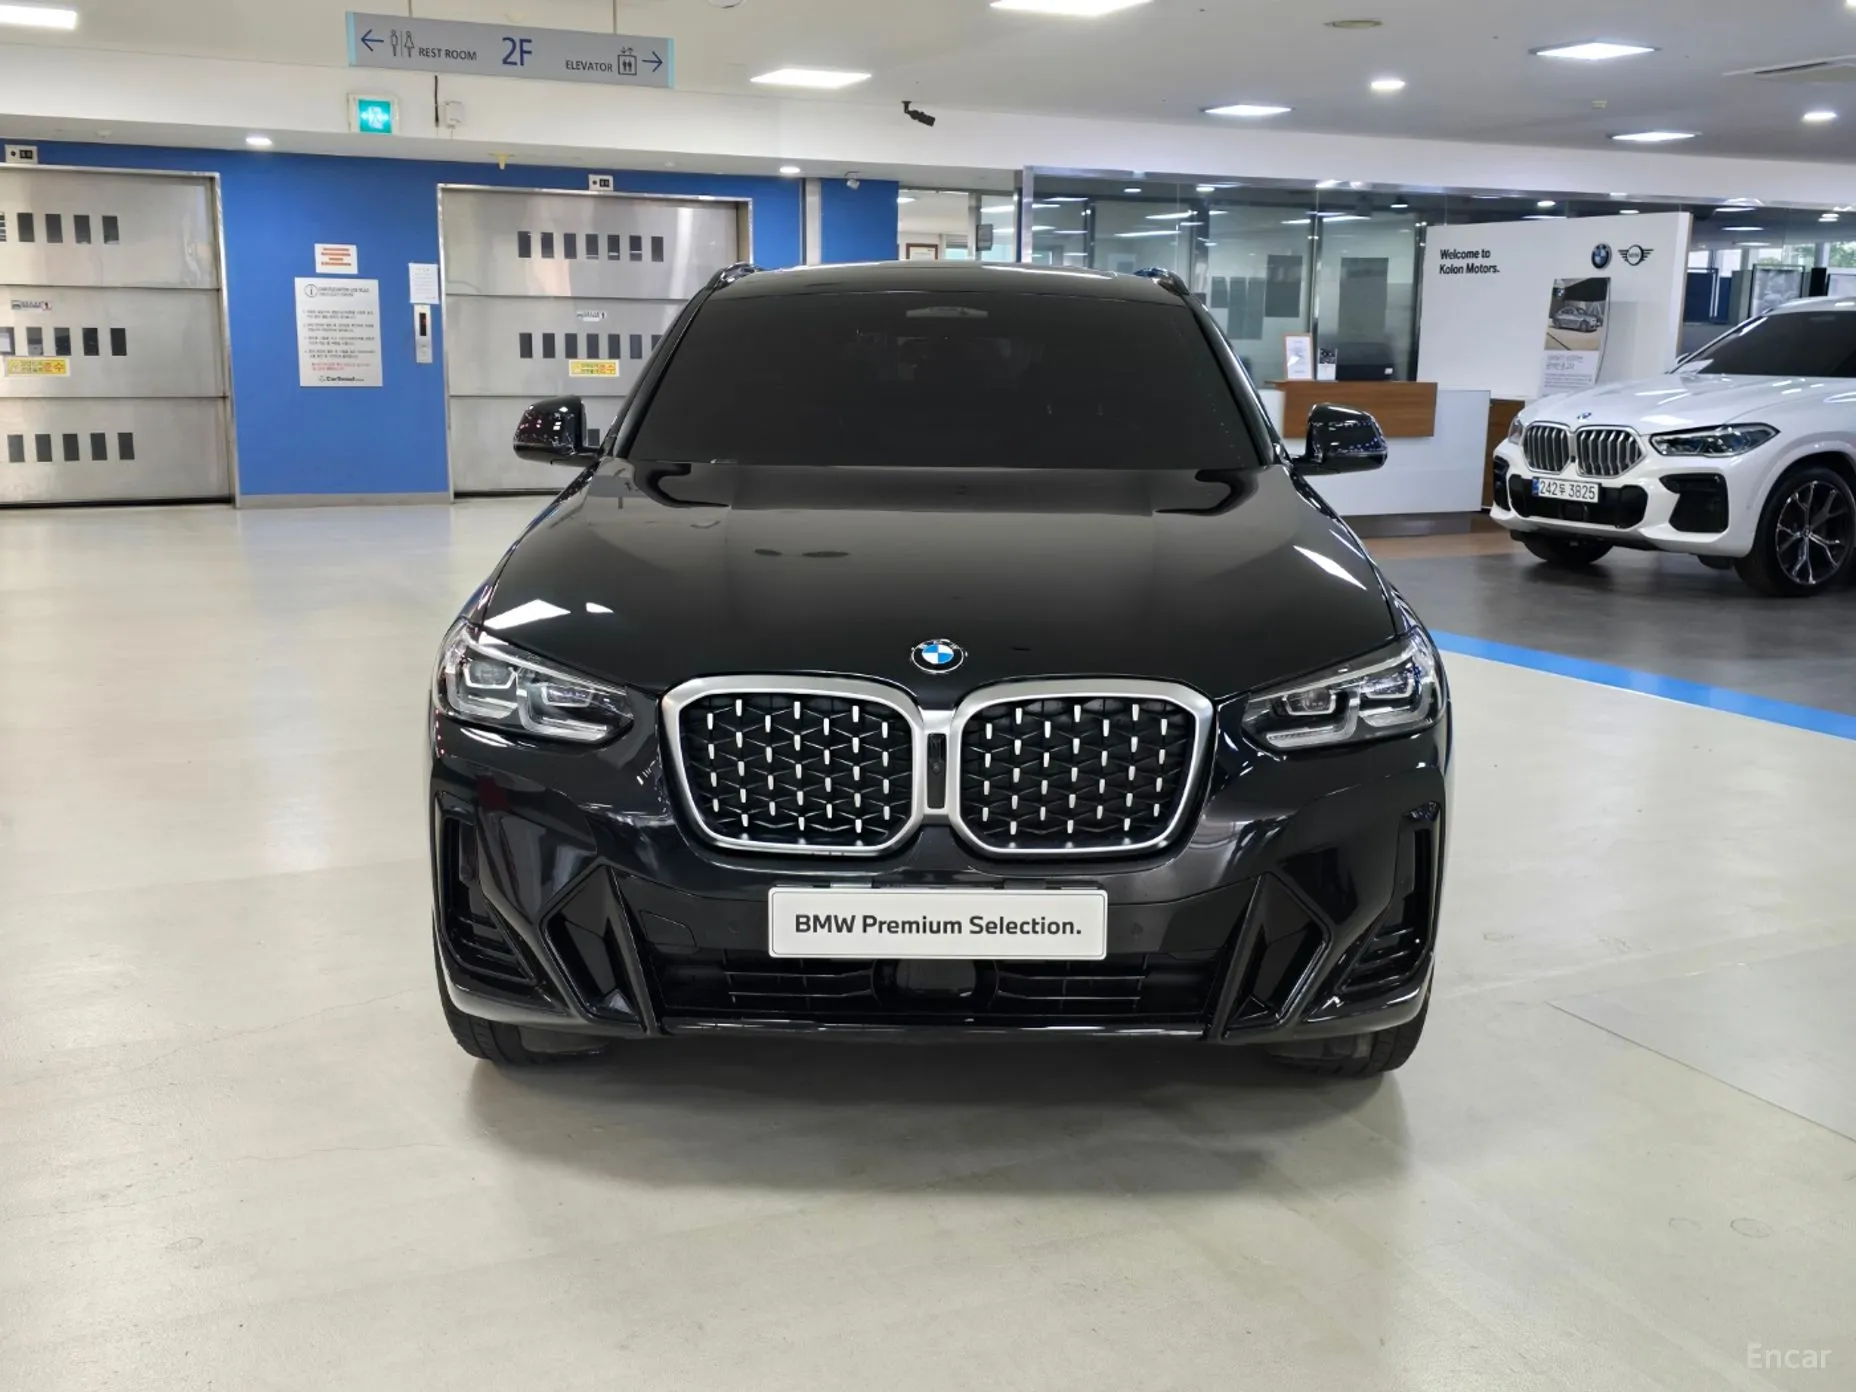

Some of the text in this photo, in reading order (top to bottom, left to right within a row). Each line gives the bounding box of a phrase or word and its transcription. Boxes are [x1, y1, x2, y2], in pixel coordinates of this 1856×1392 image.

[418, 47, 477, 61] REST ROOM
[501, 36, 533, 66] 2F
[565, 60, 613, 73] ELEVATOR
[1440, 248, 1491, 260] Welcome to
[1439, 262, 1500, 274] Kolon Motors.
[1568, 483, 1596, 500] 3825
[795, 914, 1082, 935] BMW Premium Selection.
